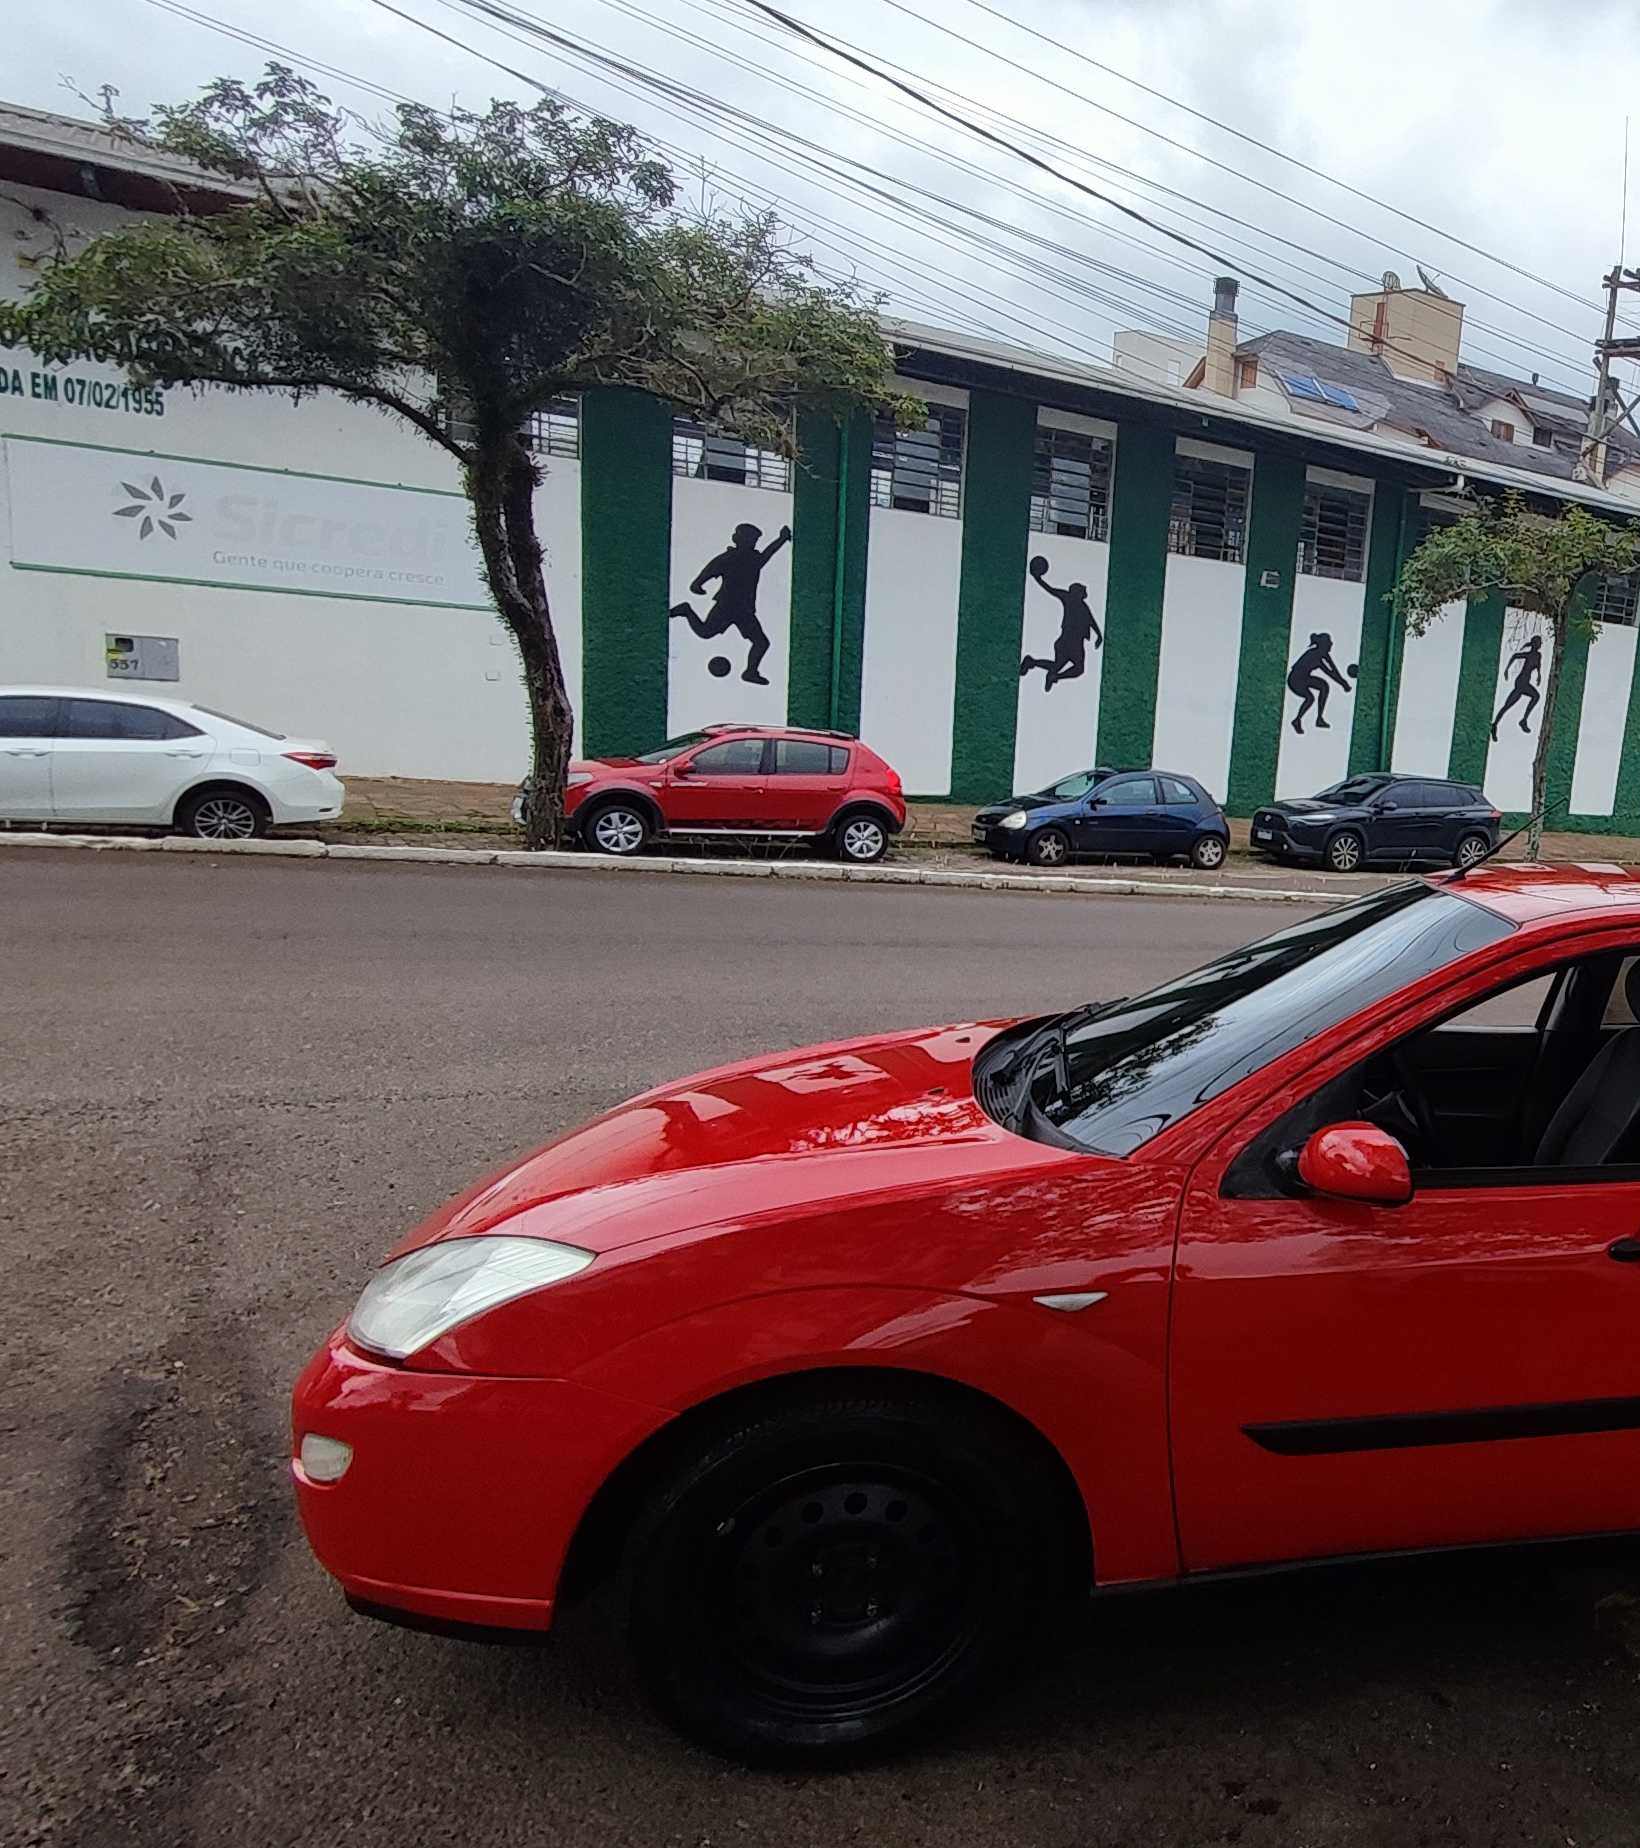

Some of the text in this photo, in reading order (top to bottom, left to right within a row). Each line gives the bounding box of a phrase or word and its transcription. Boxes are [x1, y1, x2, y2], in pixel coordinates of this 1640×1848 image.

[31, 371, 58, 401] EM
[64, 377, 164, 416] 07/02/1955
[211, 496, 448, 562] Sicredi
[213, 550, 445, 586] Gente que coopera cresce
